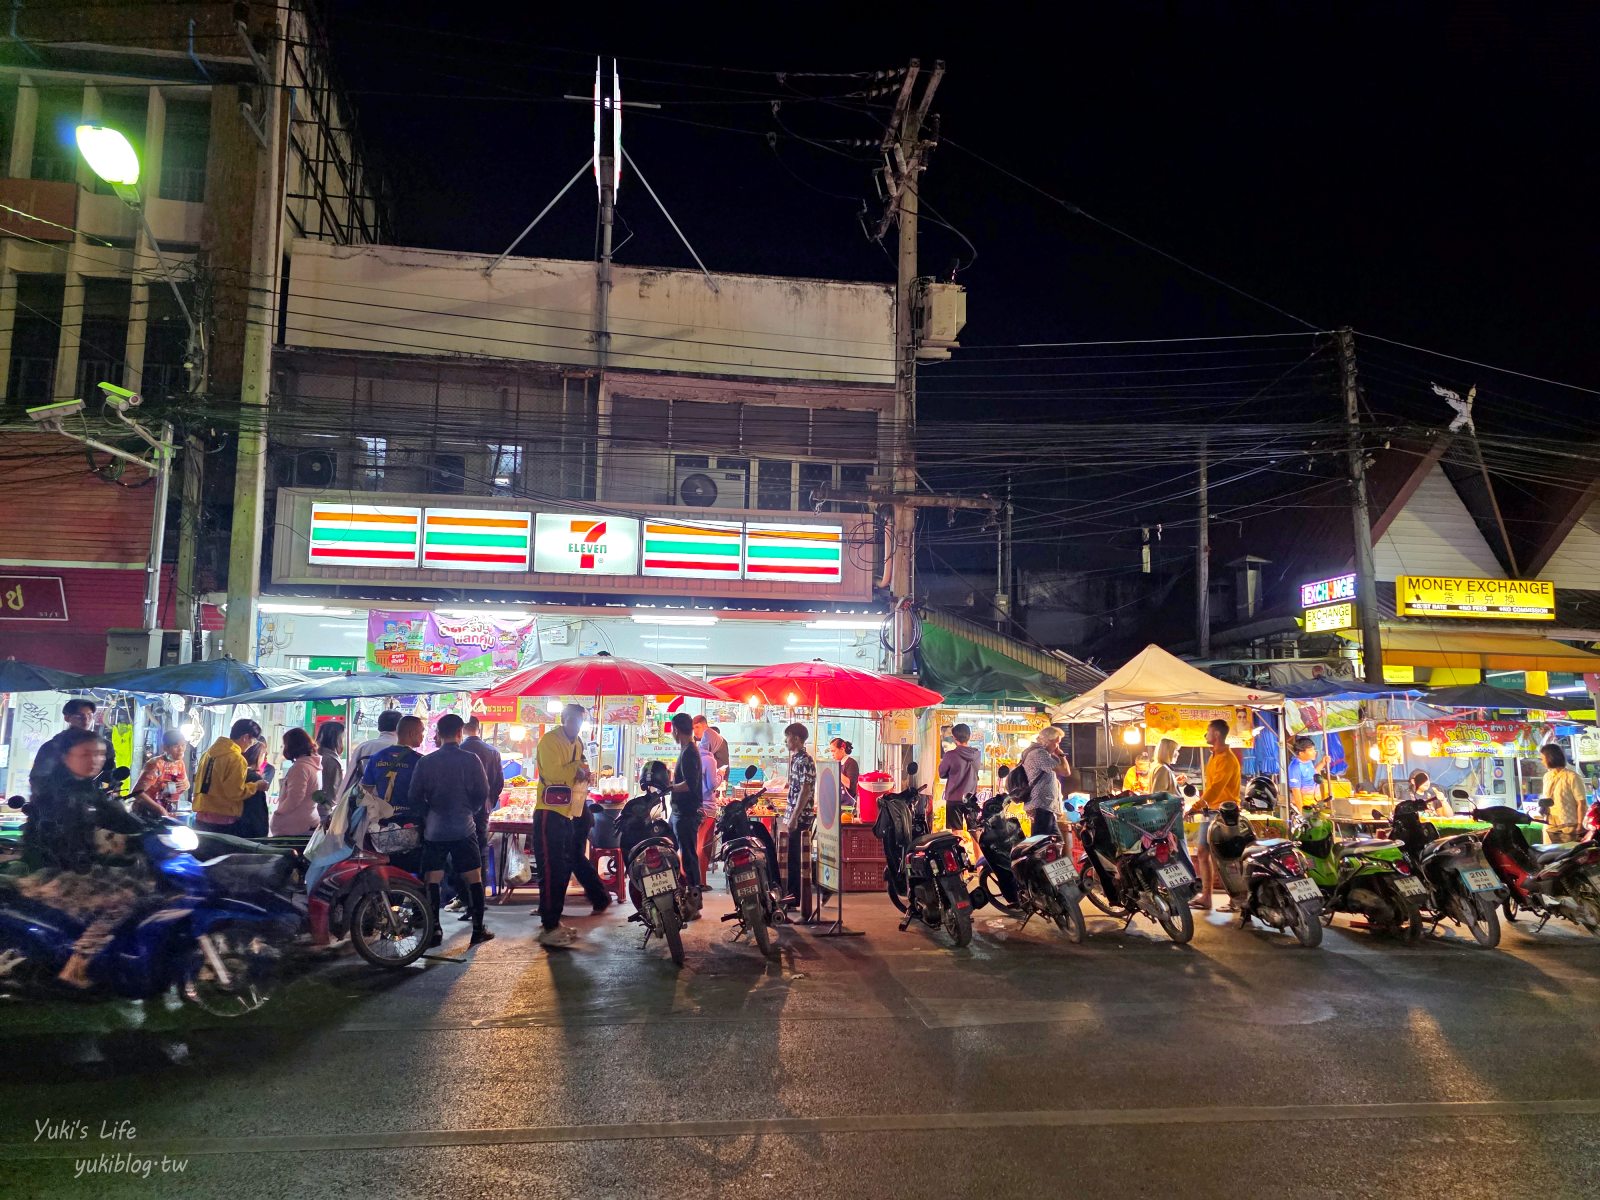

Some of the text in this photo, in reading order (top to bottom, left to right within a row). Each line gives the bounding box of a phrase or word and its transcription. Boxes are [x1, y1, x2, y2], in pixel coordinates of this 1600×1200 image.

[1304, 577, 1354, 604] EXCHANGE
[1408, 578, 1549, 594] MONEY EXCHANGE
[1308, 606, 1349, 621] EXCHANGE
